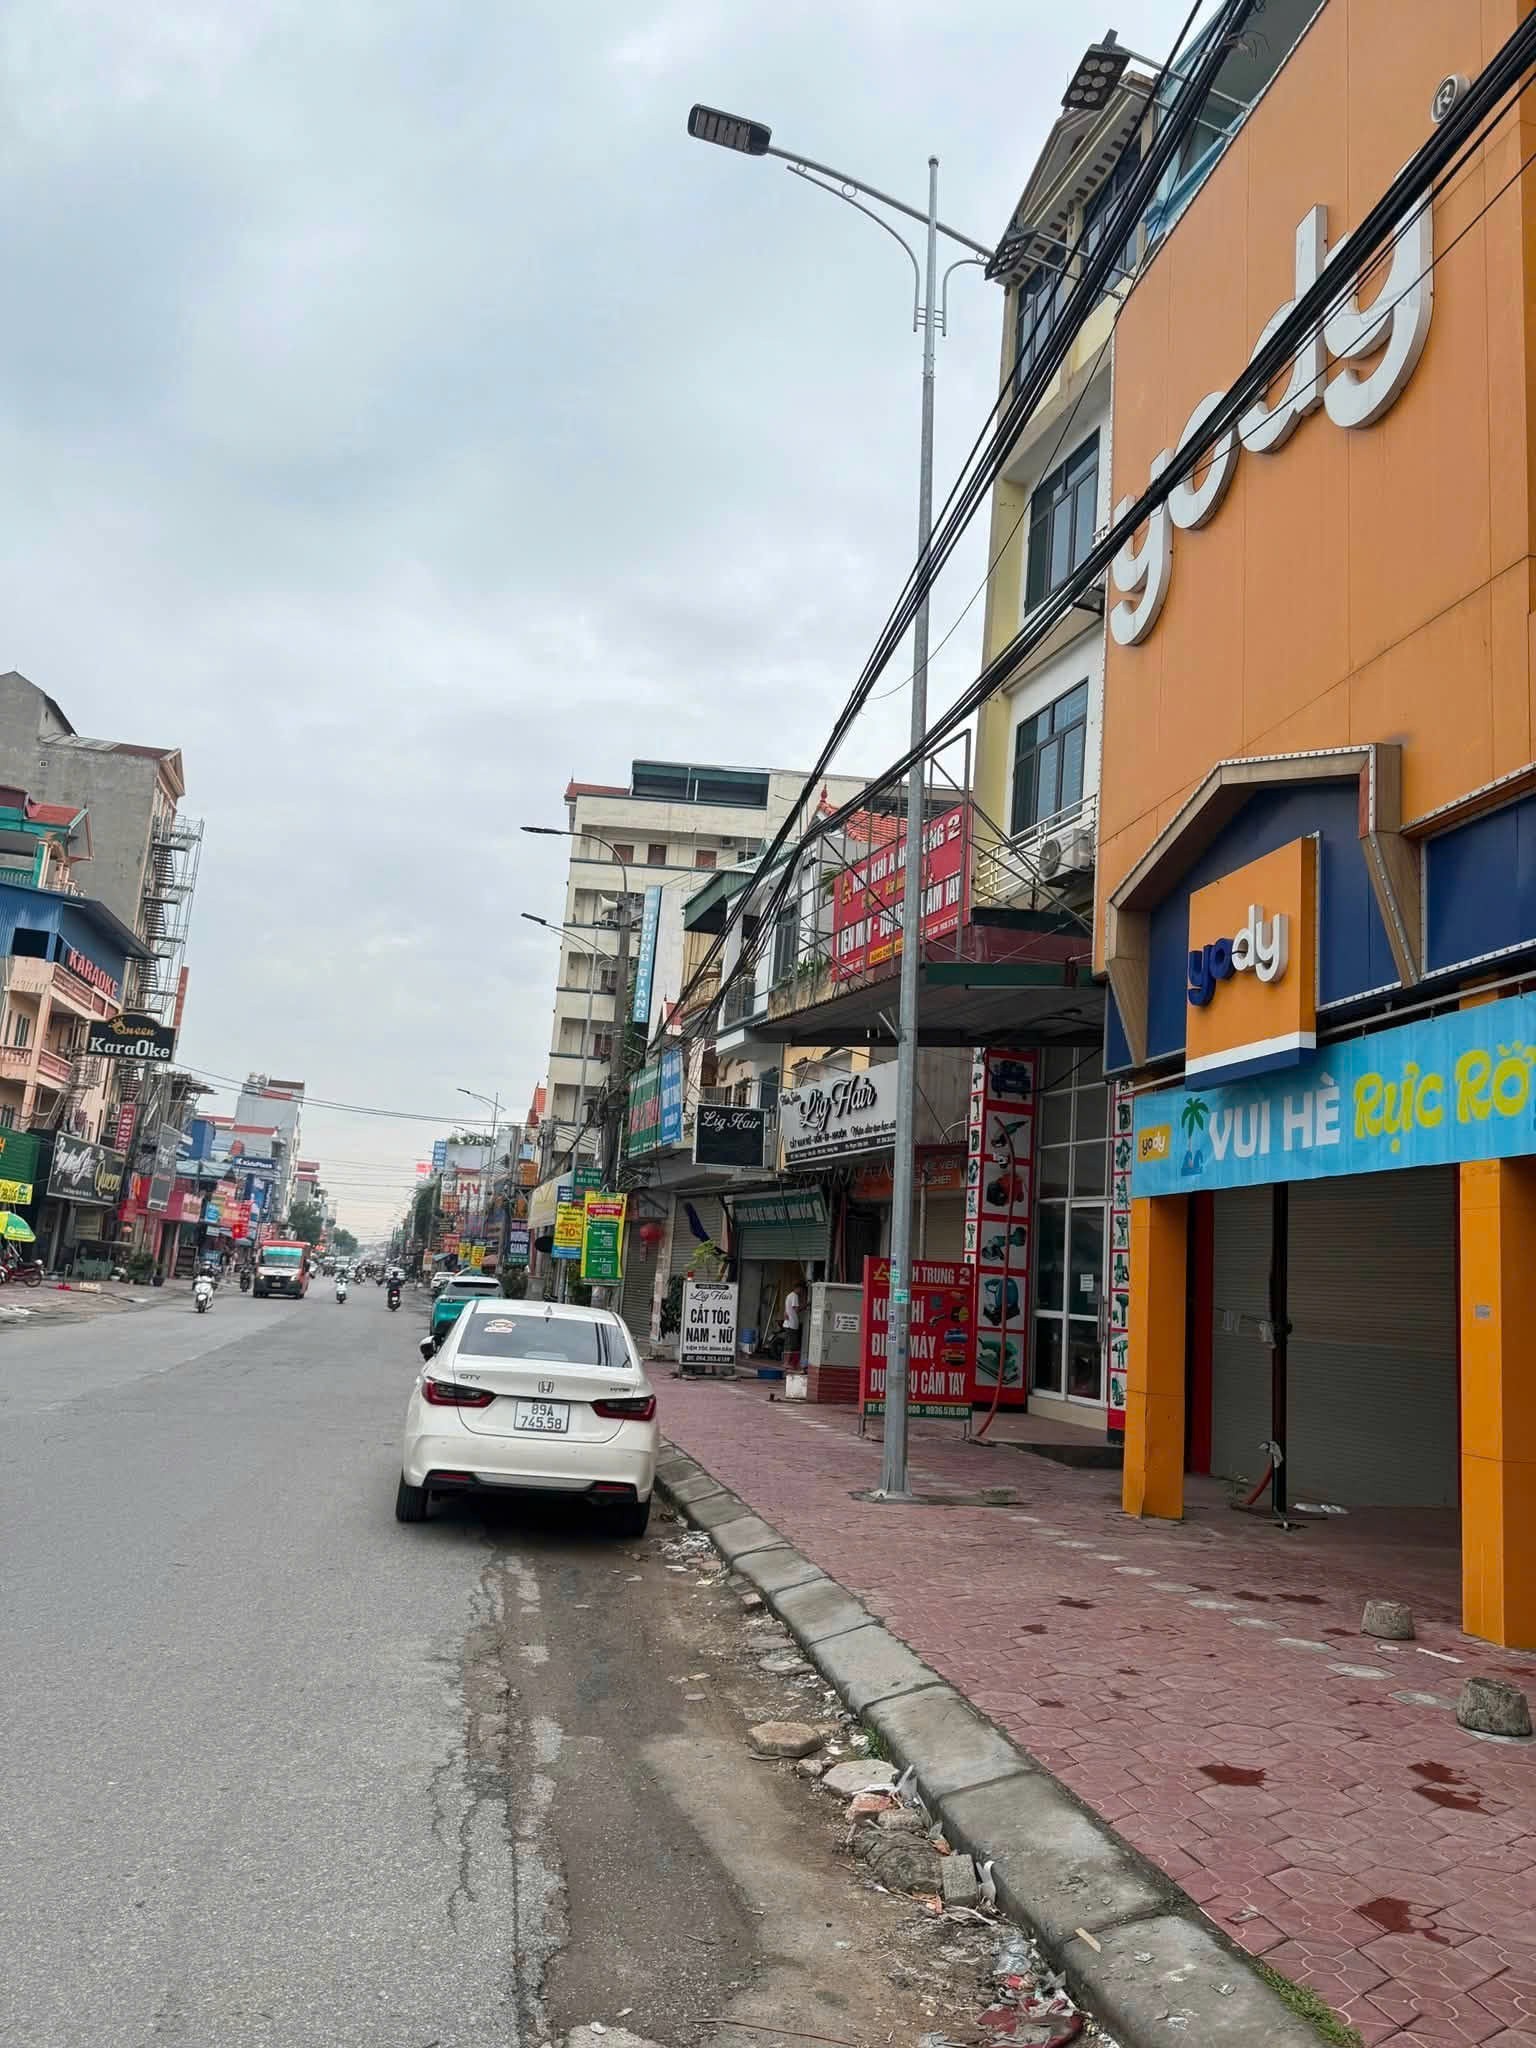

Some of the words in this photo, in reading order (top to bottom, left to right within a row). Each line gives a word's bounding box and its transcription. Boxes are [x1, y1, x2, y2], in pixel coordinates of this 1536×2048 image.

[1109, 150, 1434, 645] yody
[948, 814, 961, 841] 2
[1187, 903, 1290, 1007] yody
[70, 950, 119, 999] KARAOKE
[635, 967, 649, 1019] GIANG
[800, 1088, 832, 1132] Lig
[831, 1075, 878, 1118] Hair
[1142, 1131, 1166, 1156] yody
[1209, 1101, 1271, 1161] VUI
[1283, 1071, 1341, 1151] HÈ
[700, 1110, 727, 1132] Lig
[727, 1112, 760, 1130] Hair
[921, 1267, 955, 1286] TRUNG
[958, 1268, 971, 1286] 2
[711, 1306, 731, 1325] TÓC
[872, 1298, 889, 1321] KI
[911, 1295, 925, 1324] HÍ
[686, 1327, 710, 1343] NAM
[718, 1325, 735, 1344] NỮ
[459, 1373, 481, 1381] CITY
[920, 1364, 946, 1396] CẦM
[948, 1371, 967, 1397] TAY
[520, 1416, 563, 1430] 745.58
[530, 1404, 554, 1417] 89A
